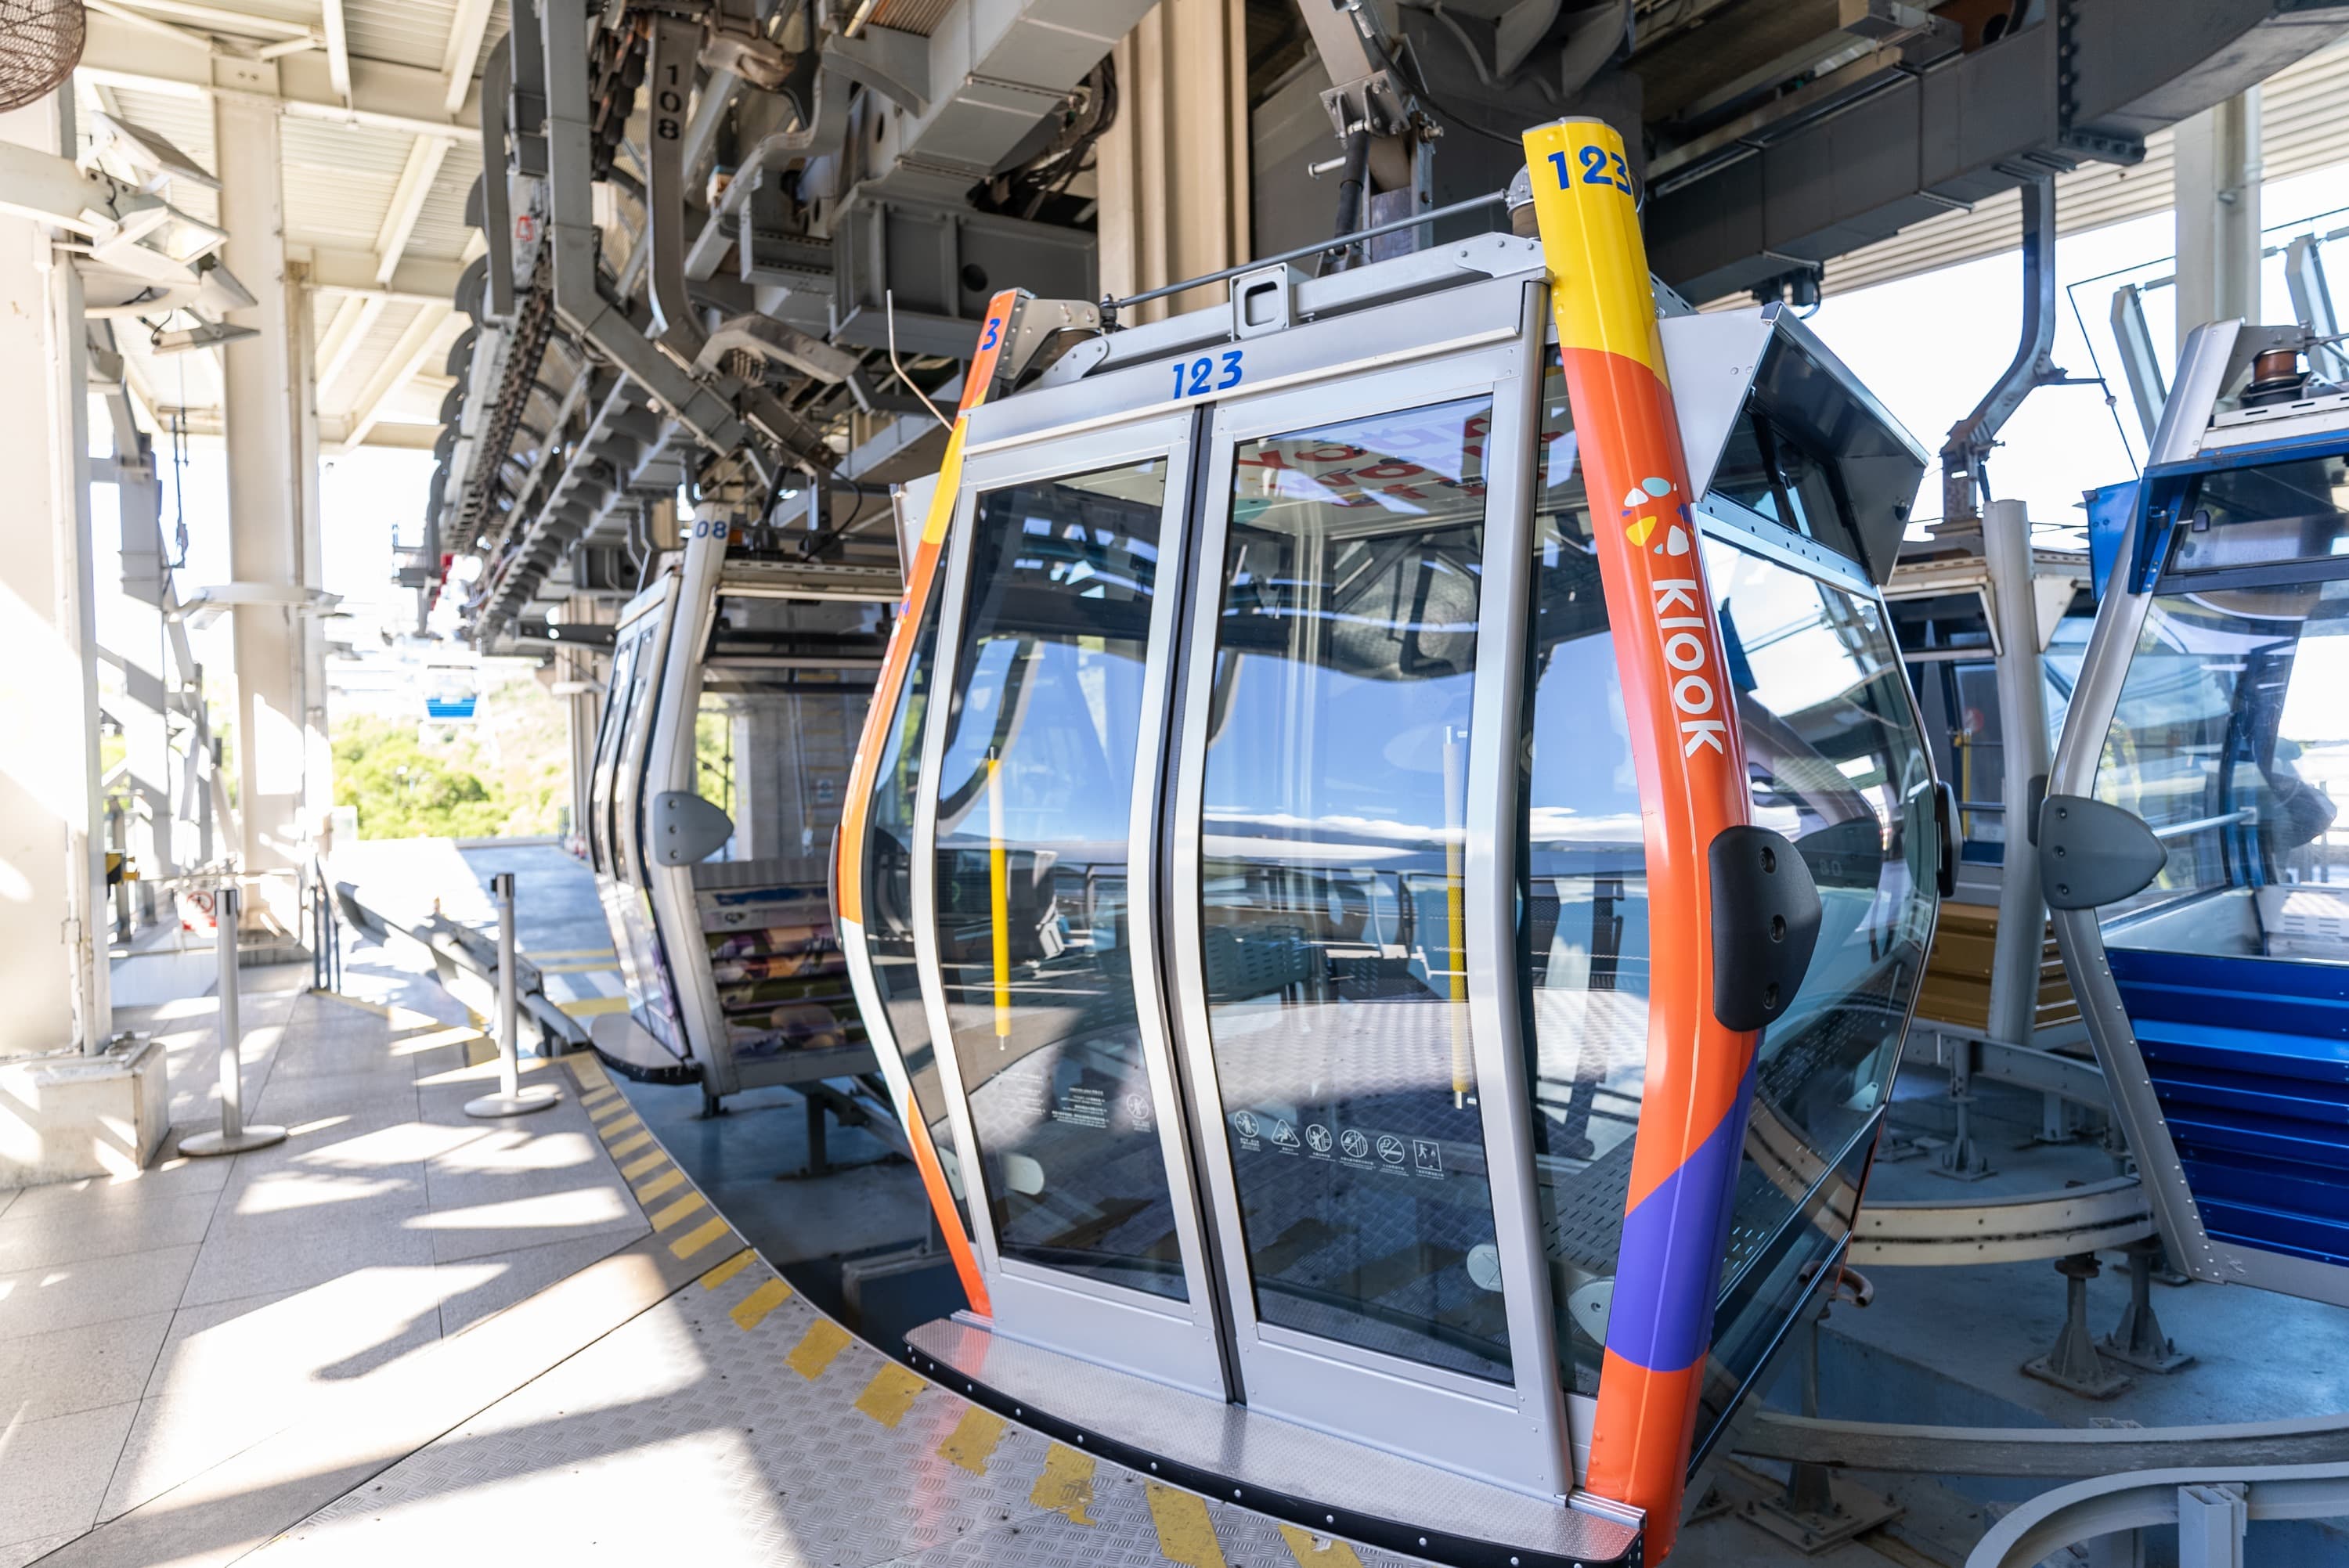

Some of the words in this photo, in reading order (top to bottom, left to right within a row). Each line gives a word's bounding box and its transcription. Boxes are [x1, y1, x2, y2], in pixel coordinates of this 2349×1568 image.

[658, 64, 680, 139] 108
[1547, 145, 1632, 196] 123
[982, 318, 1001, 351] 3
[1173, 350, 1243, 400] 123
[696, 521, 727, 539] 08
